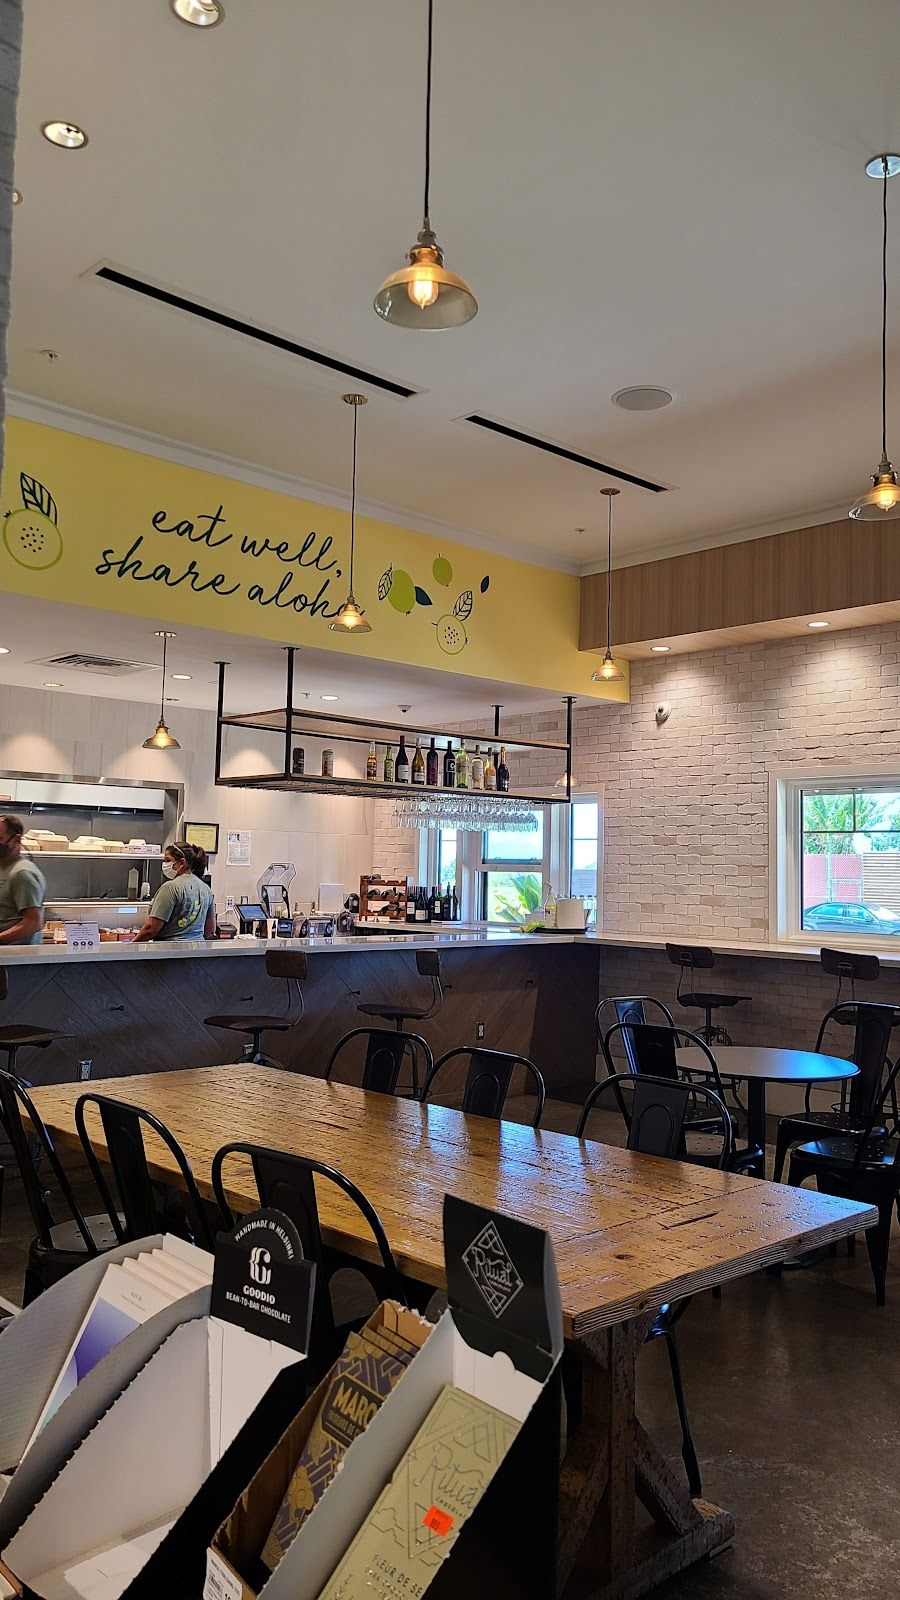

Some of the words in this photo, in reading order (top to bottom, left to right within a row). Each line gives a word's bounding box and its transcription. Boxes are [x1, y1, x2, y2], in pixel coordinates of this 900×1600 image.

[151, 505, 233, 547] eat
[240, 532, 342, 578] well,
[95, 536, 241, 596] share
[234, 1219, 269, 1242] HANDMADE
[269, 1221, 277, 1230] IN
[275, 1226, 295, 1260] HELSINKI
[470, 1246, 513, 1288] Ritual
[225, 1291, 260, 1311] BEAN-TO-BAR
[260, 1304, 291, 1324] CHOCOLATE
[243, 1285, 276, 1305] GOODIO
[412, 1441, 485, 1510] Ritua
[372, 1553, 397, 1578] FLEUR
[397, 1573, 411, 1588] DE
